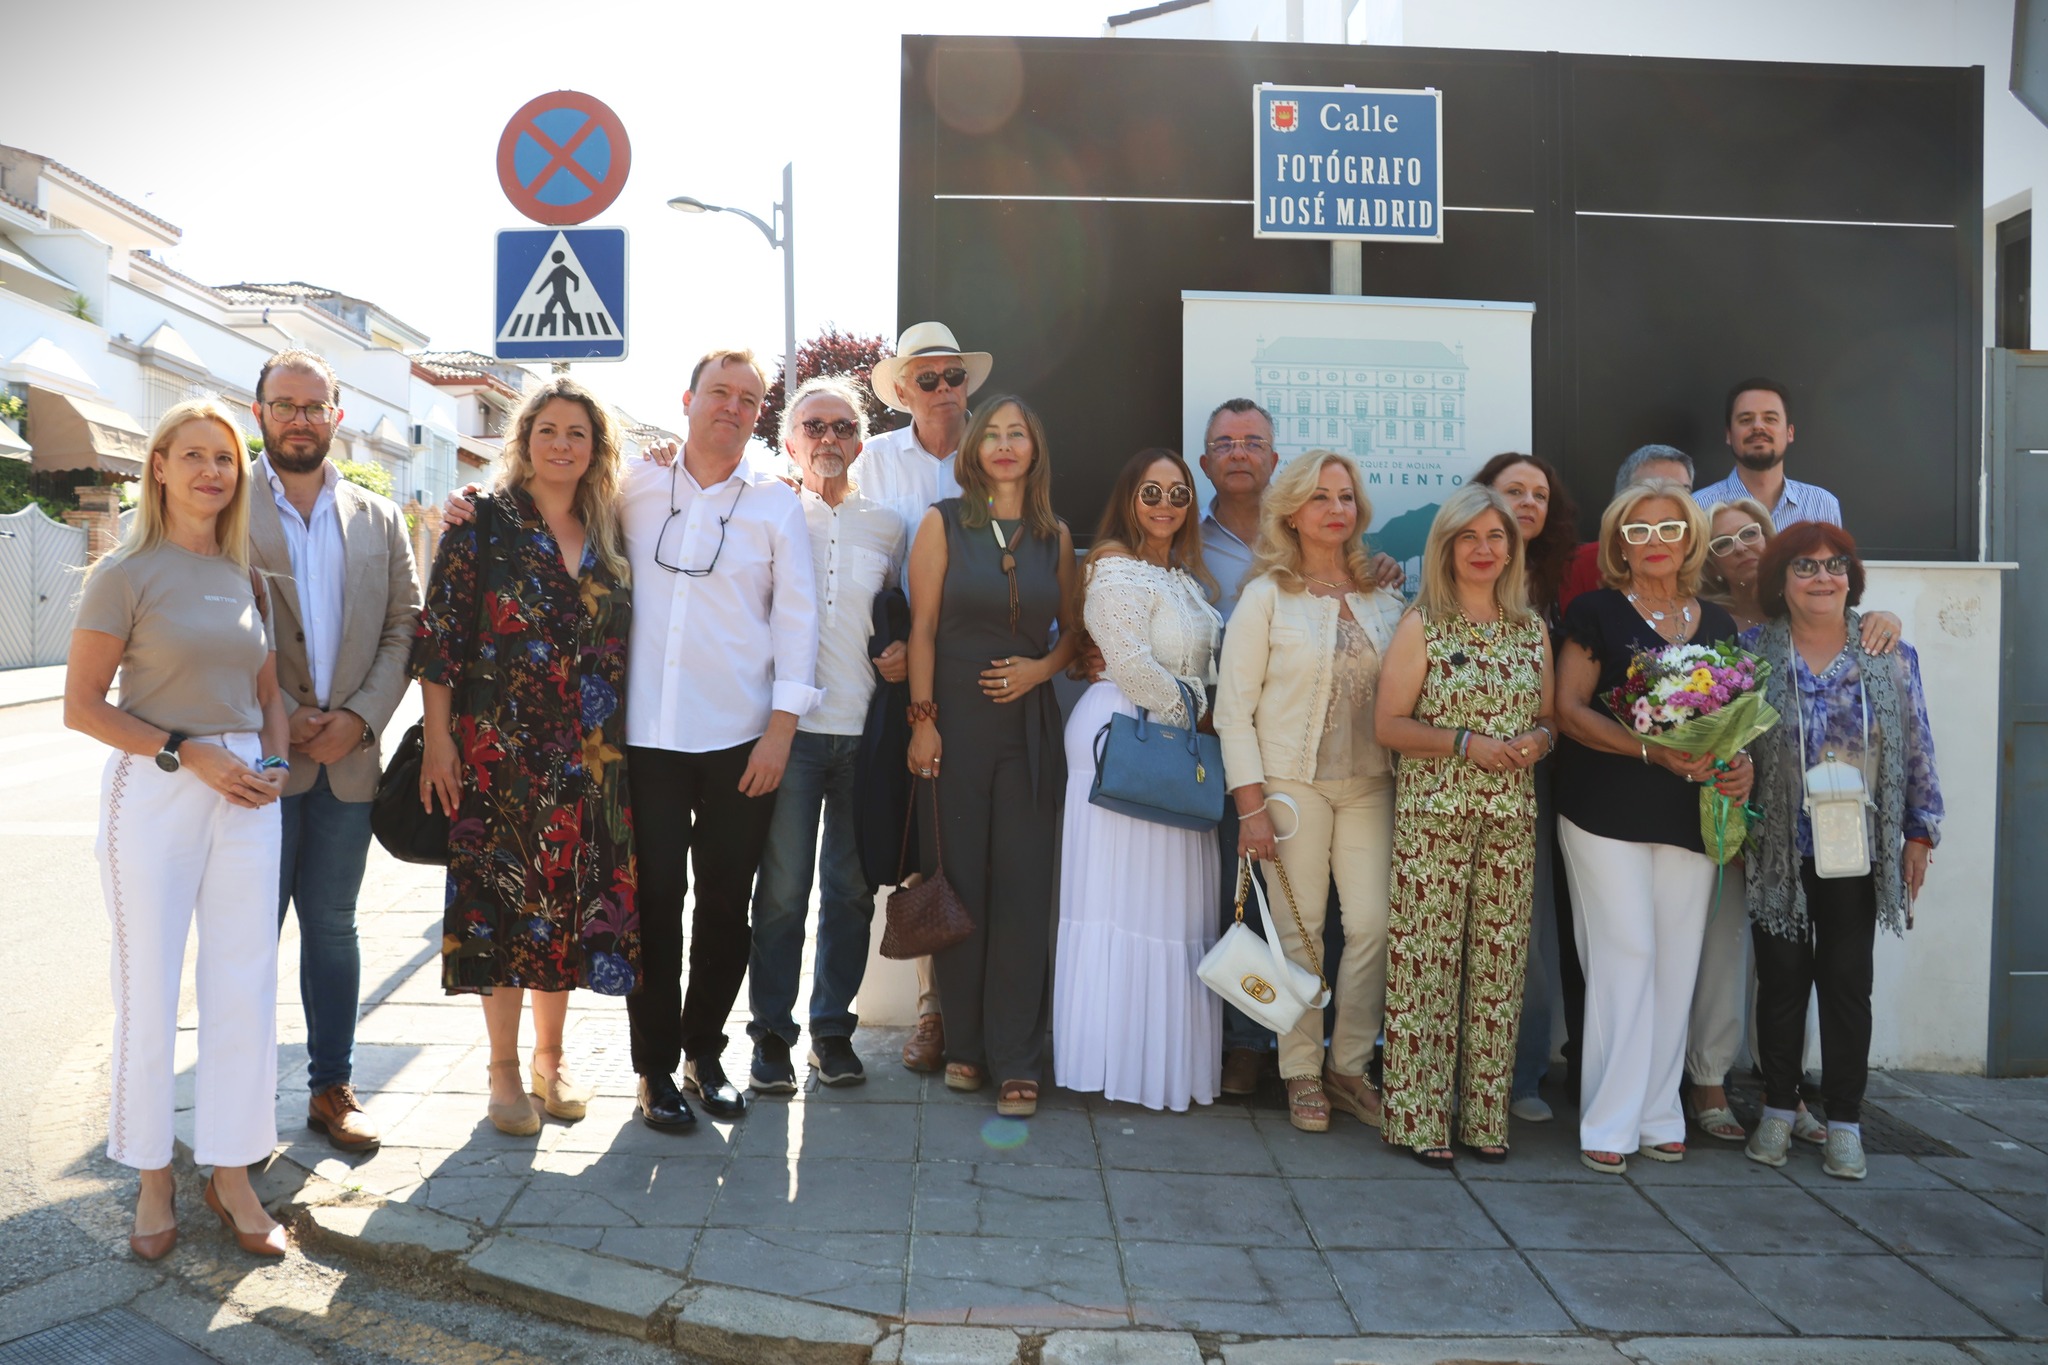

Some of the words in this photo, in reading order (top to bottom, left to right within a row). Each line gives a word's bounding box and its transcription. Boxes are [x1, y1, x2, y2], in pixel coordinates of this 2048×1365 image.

[1320, 103, 1398, 133] Calle
[1277, 149, 1421, 186] FOTÓGRAFO
[1265, 191, 1325, 226] JOSÉ
[1336, 198, 1433, 228] MADRID
[1360, 461, 1388, 469] ZQUEZ
[1392, 461, 1402, 469] DE
[1407, 462, 1442, 470] MOLINA
[1369, 473, 1463, 486] MIENTO
